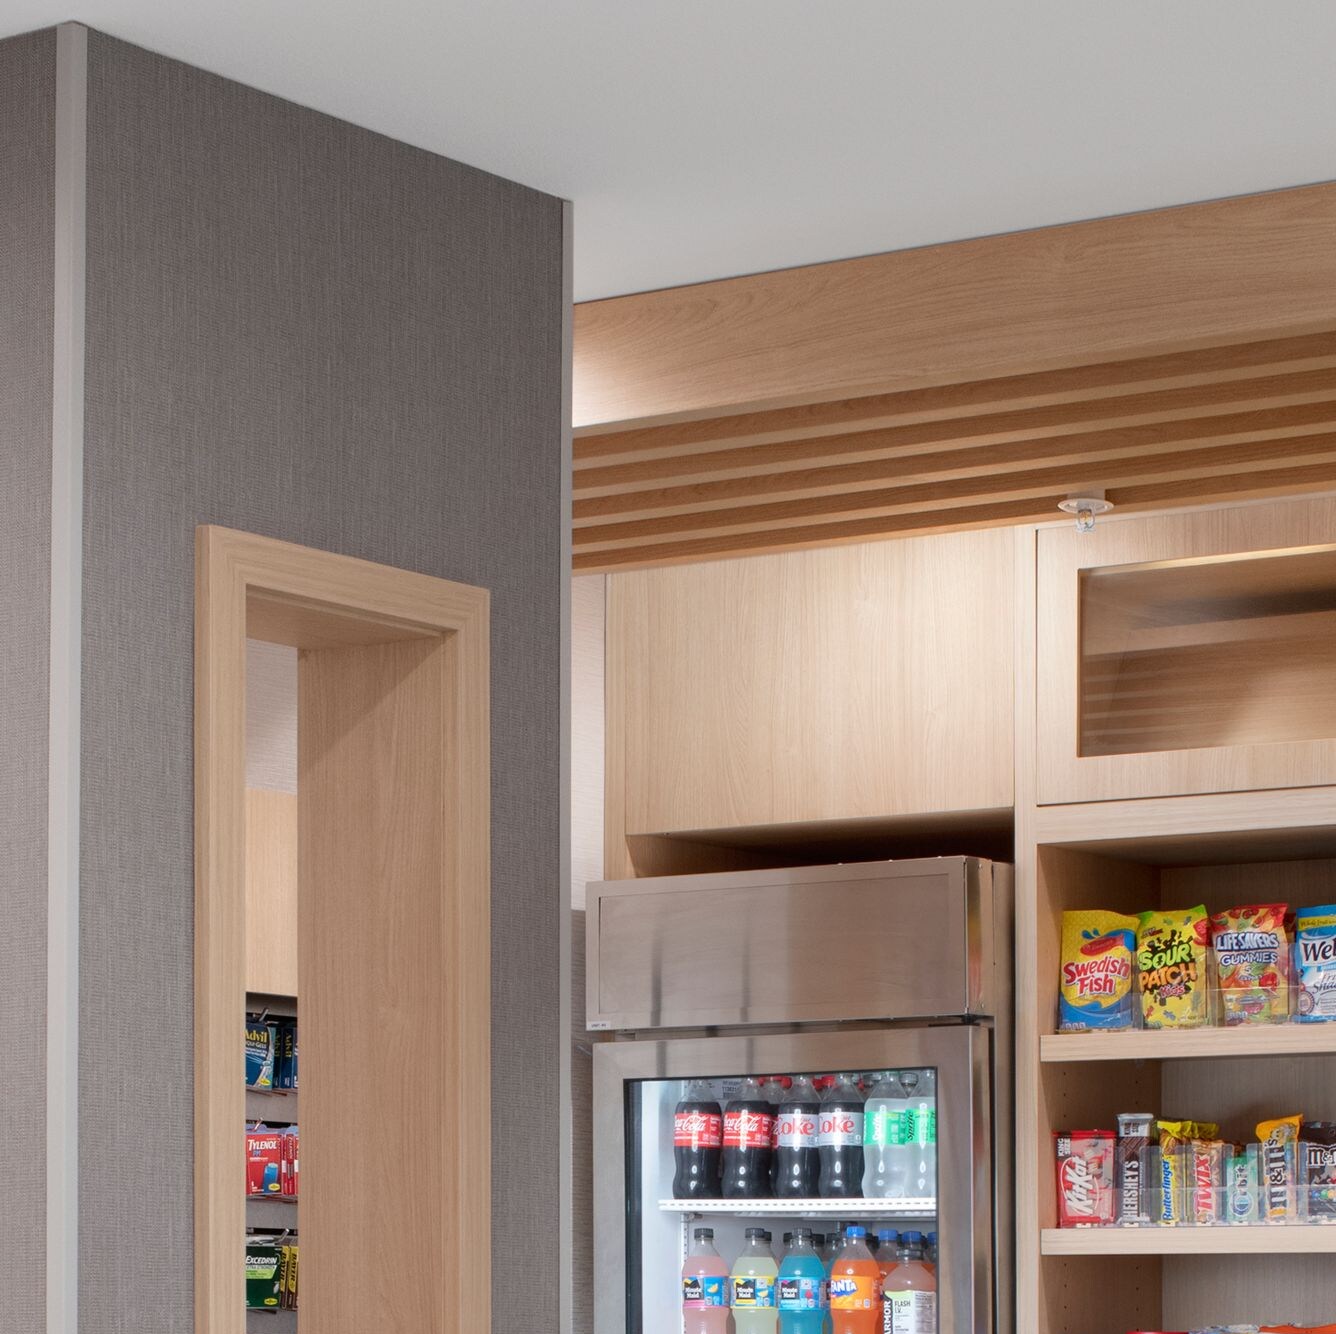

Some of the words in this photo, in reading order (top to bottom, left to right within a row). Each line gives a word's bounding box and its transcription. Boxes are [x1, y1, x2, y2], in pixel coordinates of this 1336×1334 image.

[1139, 943, 1191, 970] SOUR
[1221, 952, 1277, 966] GUMMIES
[1063, 956, 1130, 985] Swedish
[1138, 962, 1197, 993] PATCH
[1077, 975, 1115, 996] Fish
[248, 1139, 277, 1151] TYLENOL
[1162, 1160, 1173, 1220] Butterfinger
[1194, 1154, 1212, 1214] TWIX
[246, 1256, 278, 1265] EXCEDRIN
